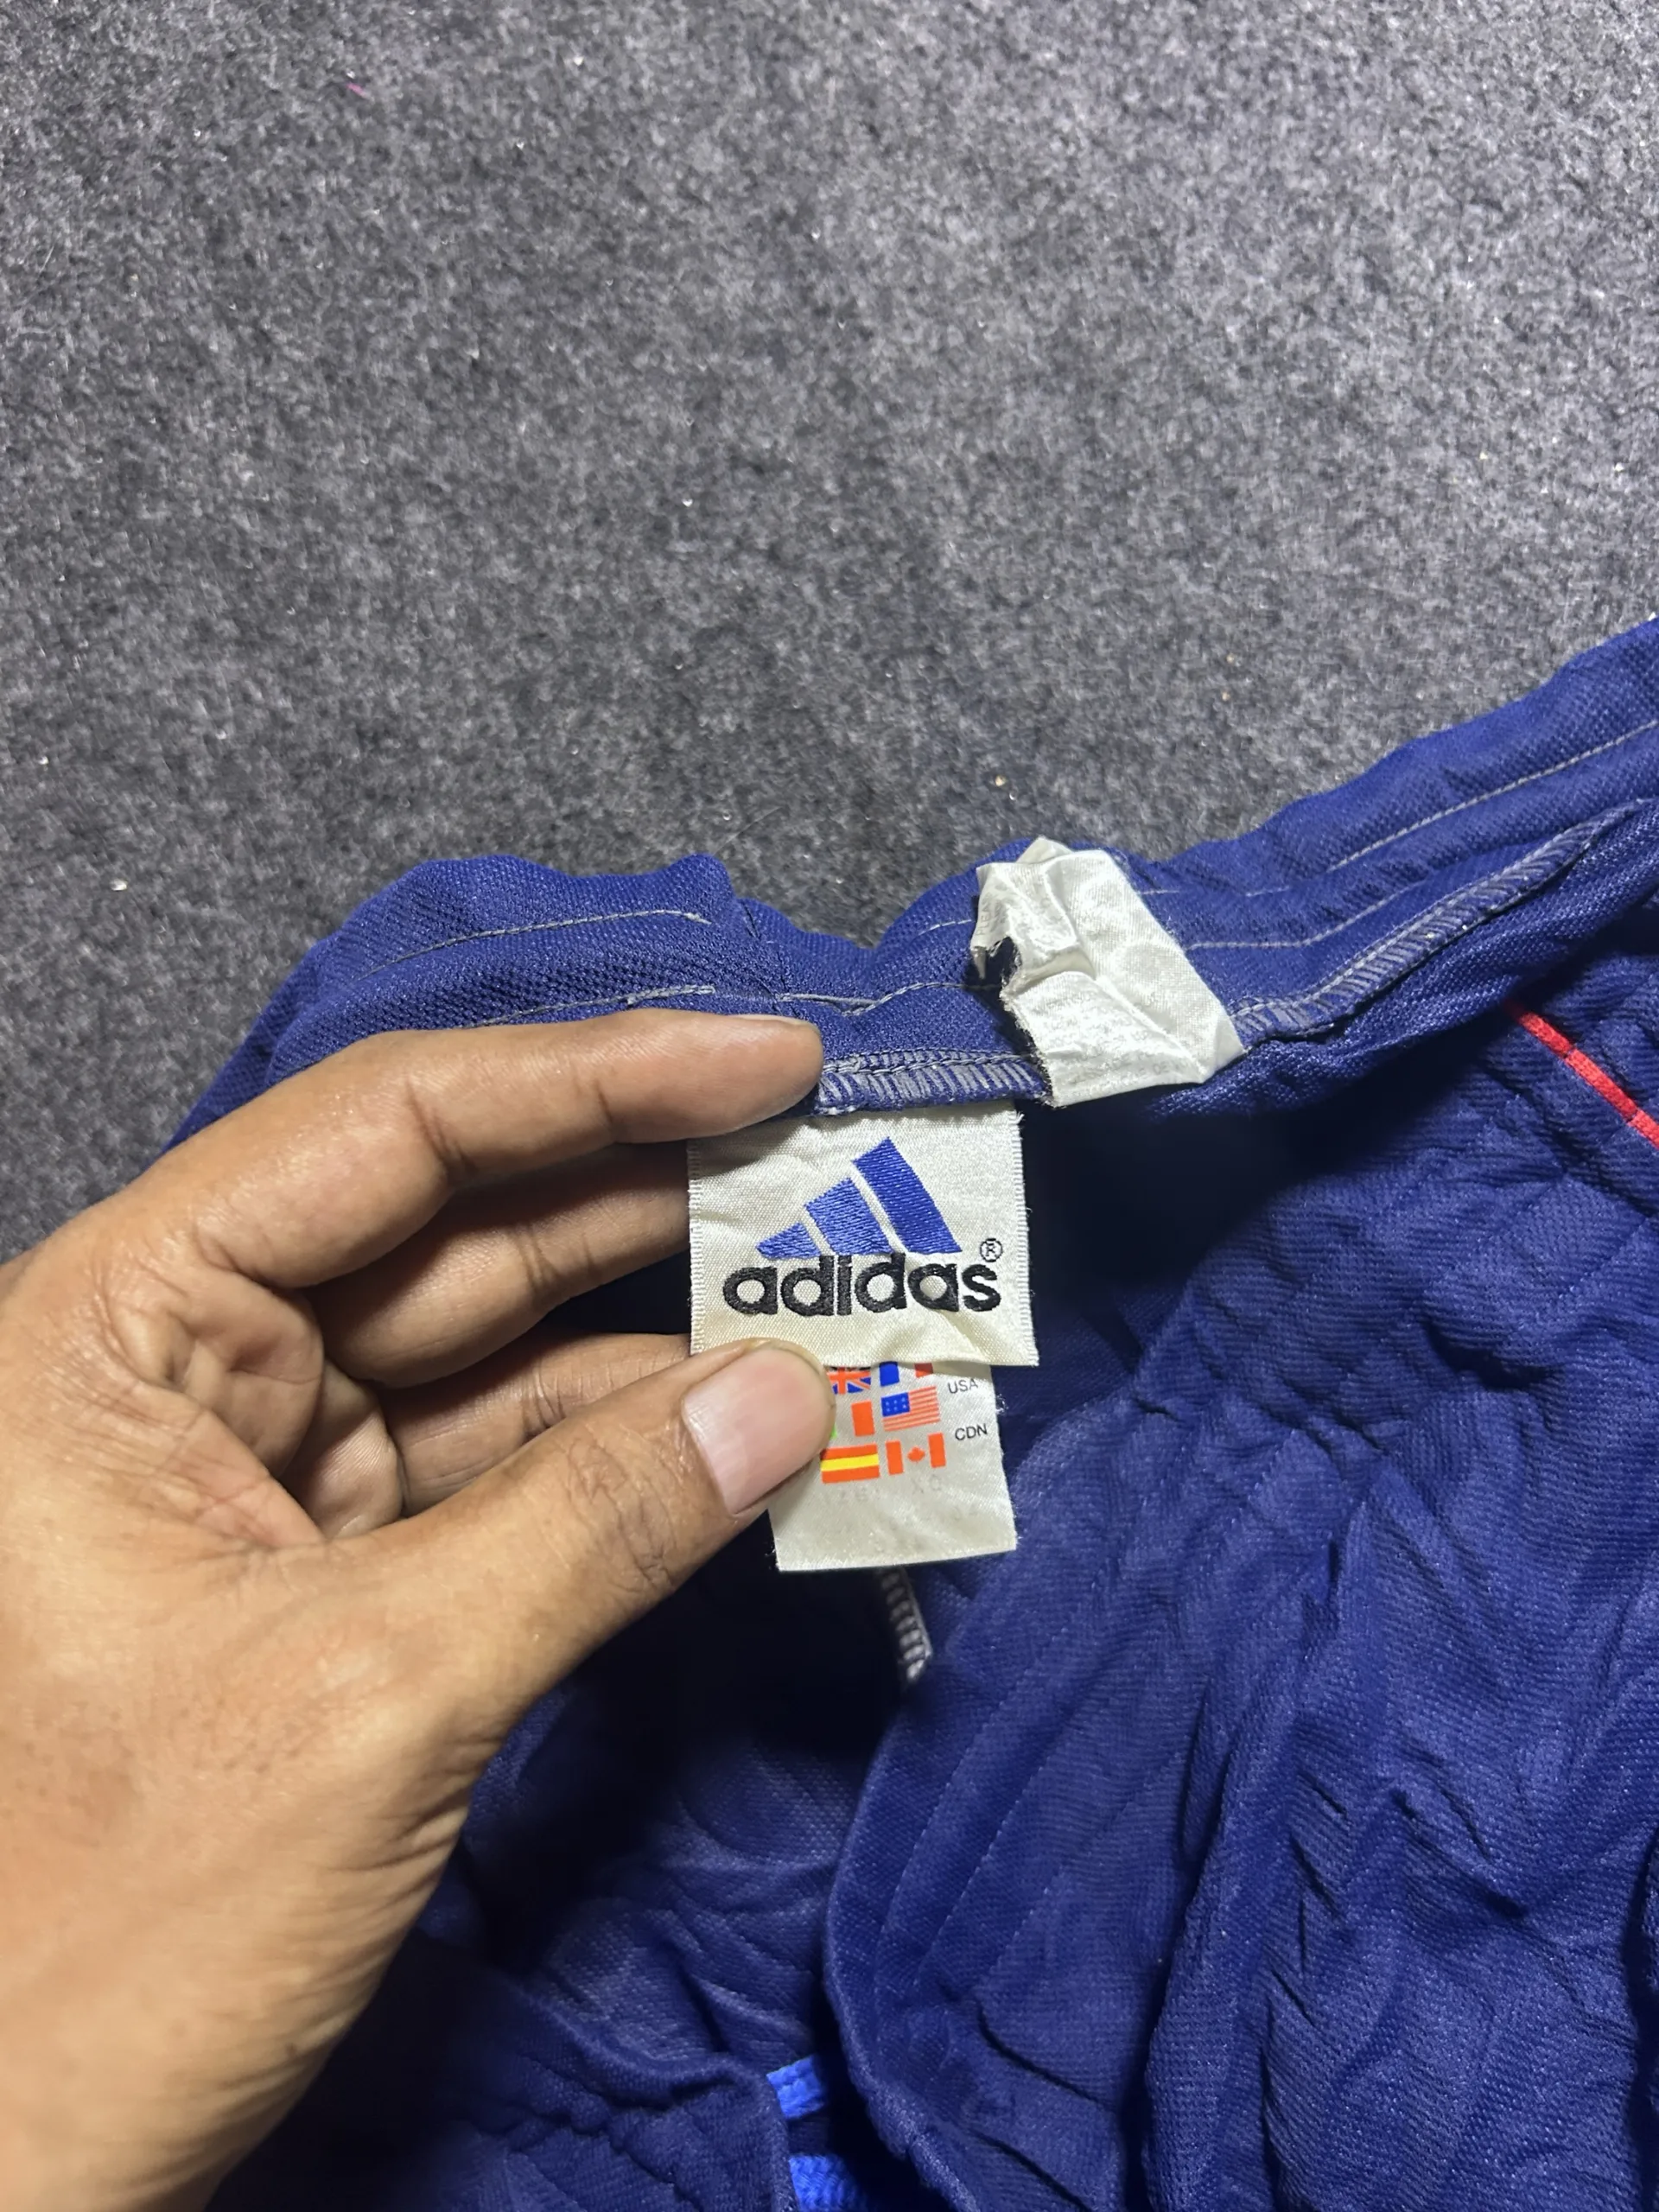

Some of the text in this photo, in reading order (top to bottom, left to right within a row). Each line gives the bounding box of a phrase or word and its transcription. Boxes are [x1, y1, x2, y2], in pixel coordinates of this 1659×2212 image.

[723, 1252, 1001, 1317] adidas
[948, 1378, 979, 1394] USA
[955, 1423, 988, 1441] CDN
